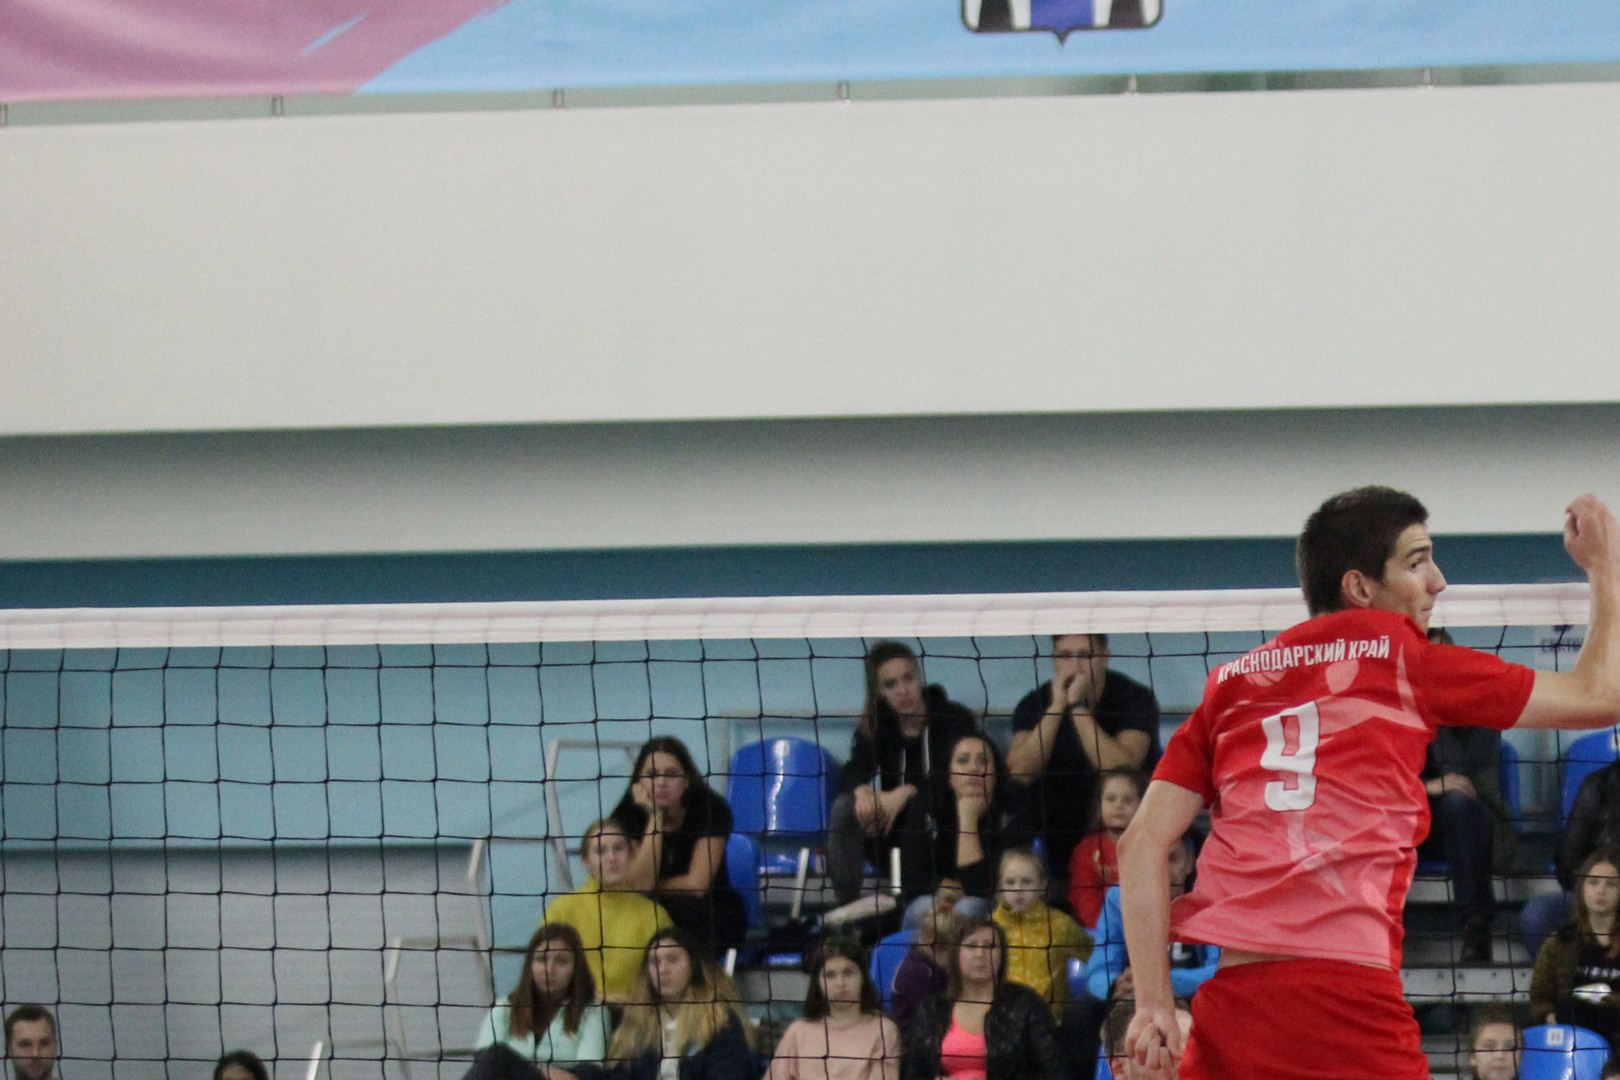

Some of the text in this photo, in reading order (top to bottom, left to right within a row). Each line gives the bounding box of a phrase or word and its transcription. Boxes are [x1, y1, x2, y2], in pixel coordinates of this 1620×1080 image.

[1217, 635, 1391, 684] КРАСНОДАРСКИЙ КРАЙ
[1260, 700, 1321, 812] 9
